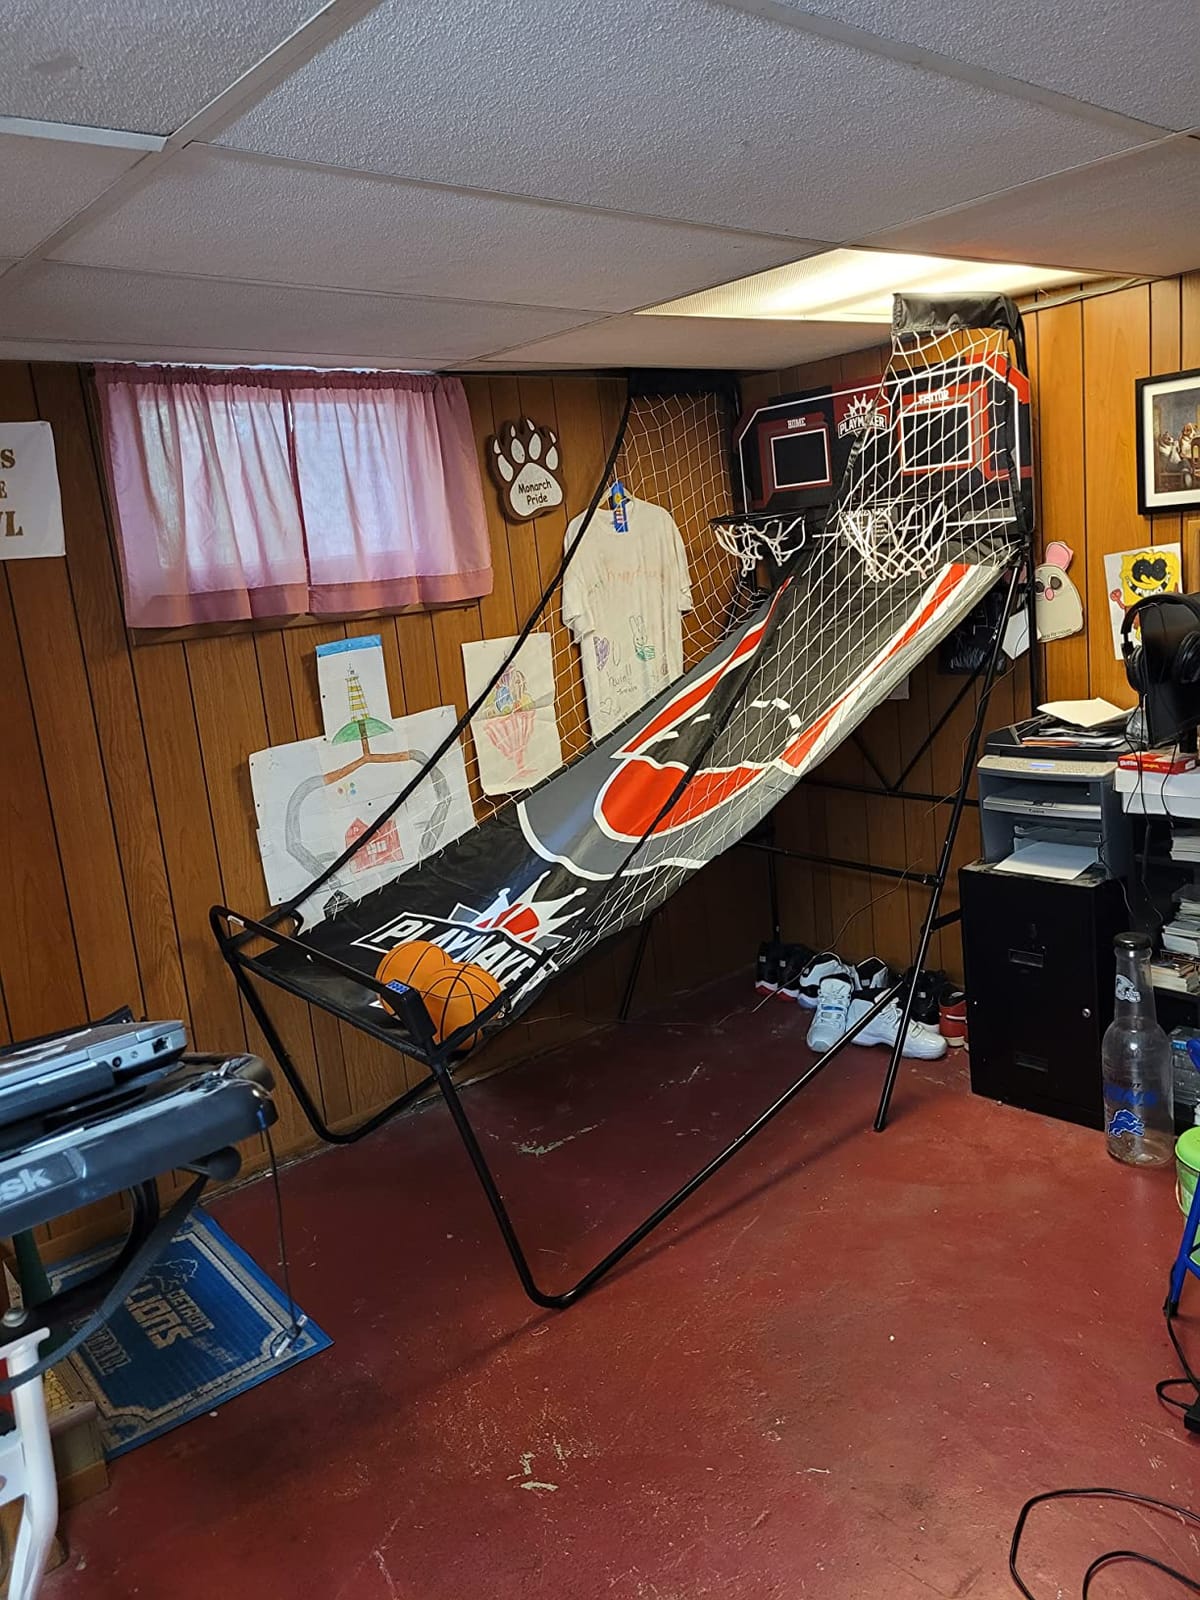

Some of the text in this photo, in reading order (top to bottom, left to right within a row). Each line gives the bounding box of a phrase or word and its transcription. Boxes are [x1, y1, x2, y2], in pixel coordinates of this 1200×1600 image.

[840, 415, 885, 435] PLAYMKER
[518, 478, 552, 494] Monarch
[526, 493, 549, 506] Pride
[0, 510, 24, 537] L
[125, 1283, 193, 1350] LIONS
